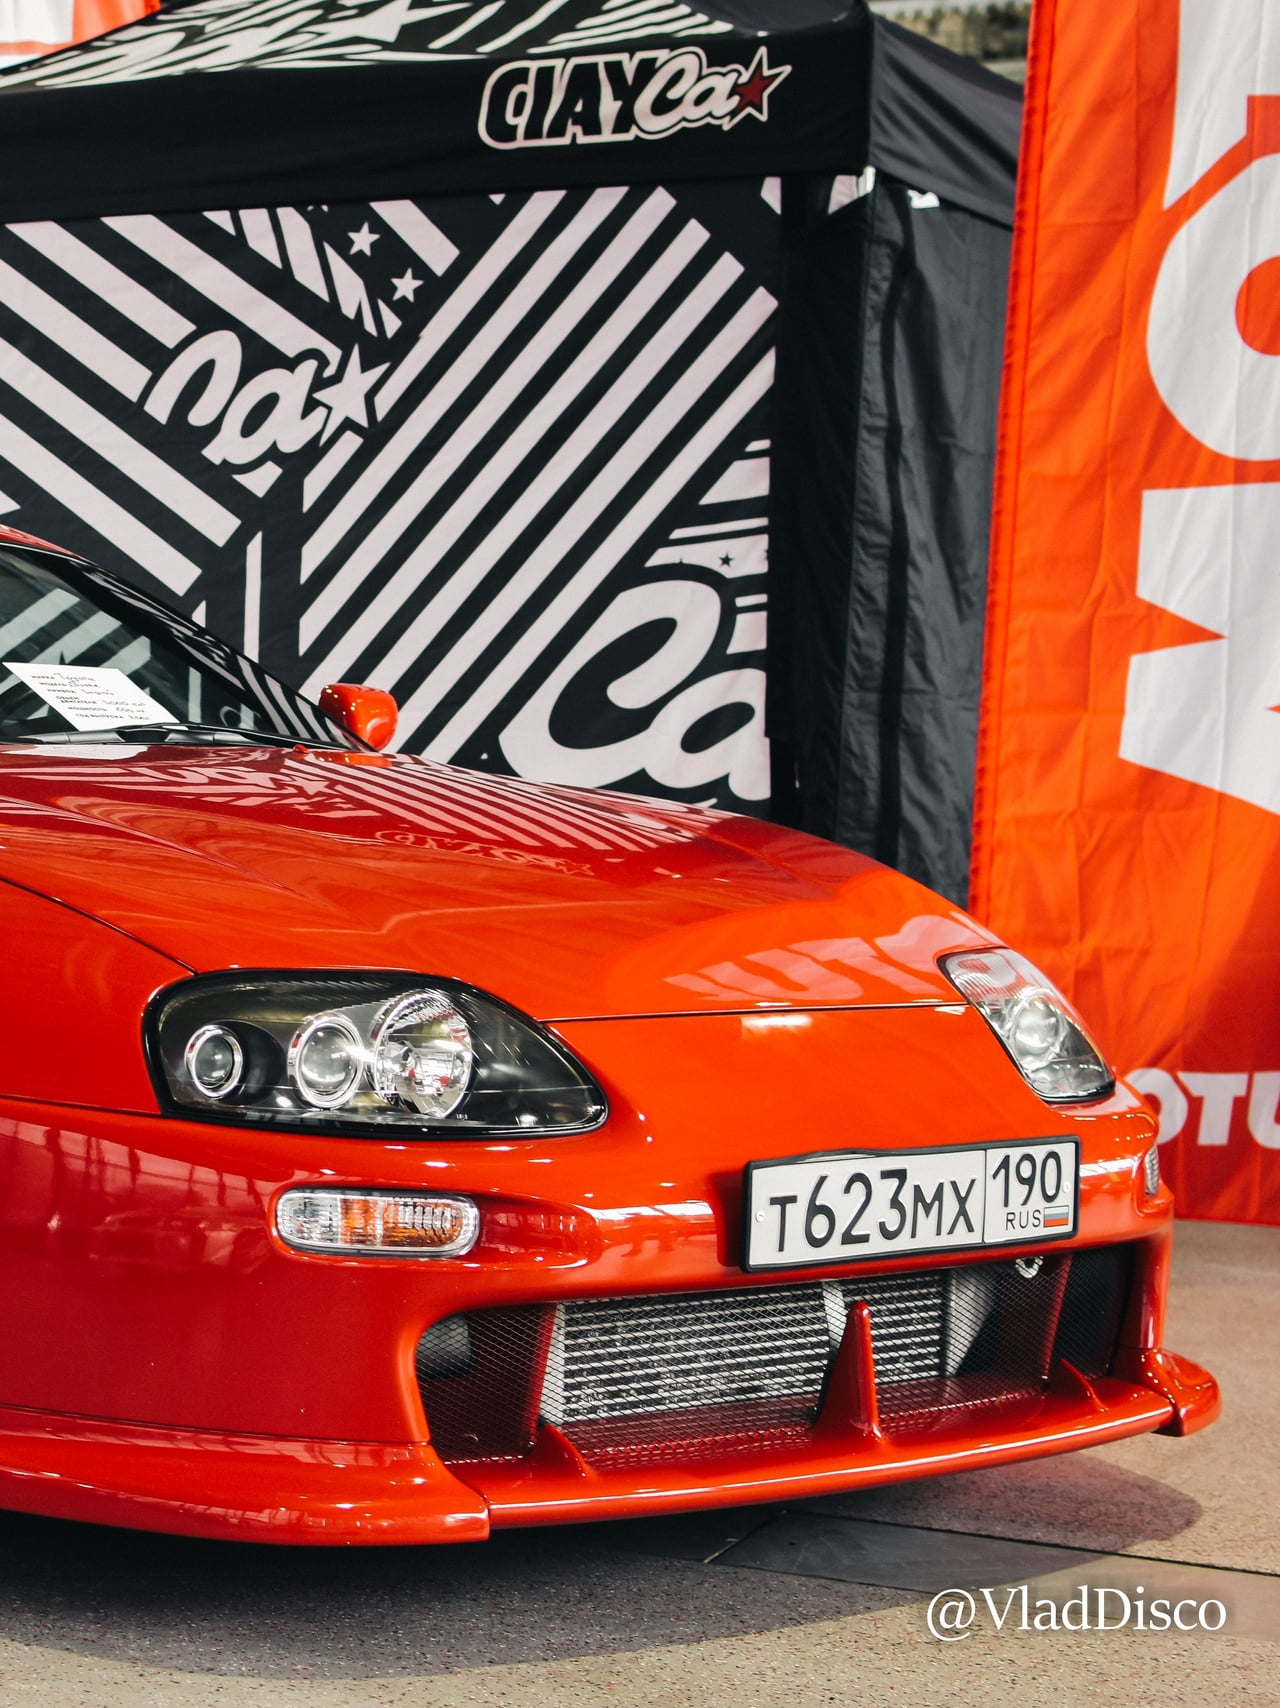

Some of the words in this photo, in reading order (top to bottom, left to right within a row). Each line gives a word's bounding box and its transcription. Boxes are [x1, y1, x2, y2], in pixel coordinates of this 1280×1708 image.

[770, 1168, 976, 1252] T623MX
[992, 1150, 1062, 1207] 190
[1006, 1209, 1042, 1232] RUS
